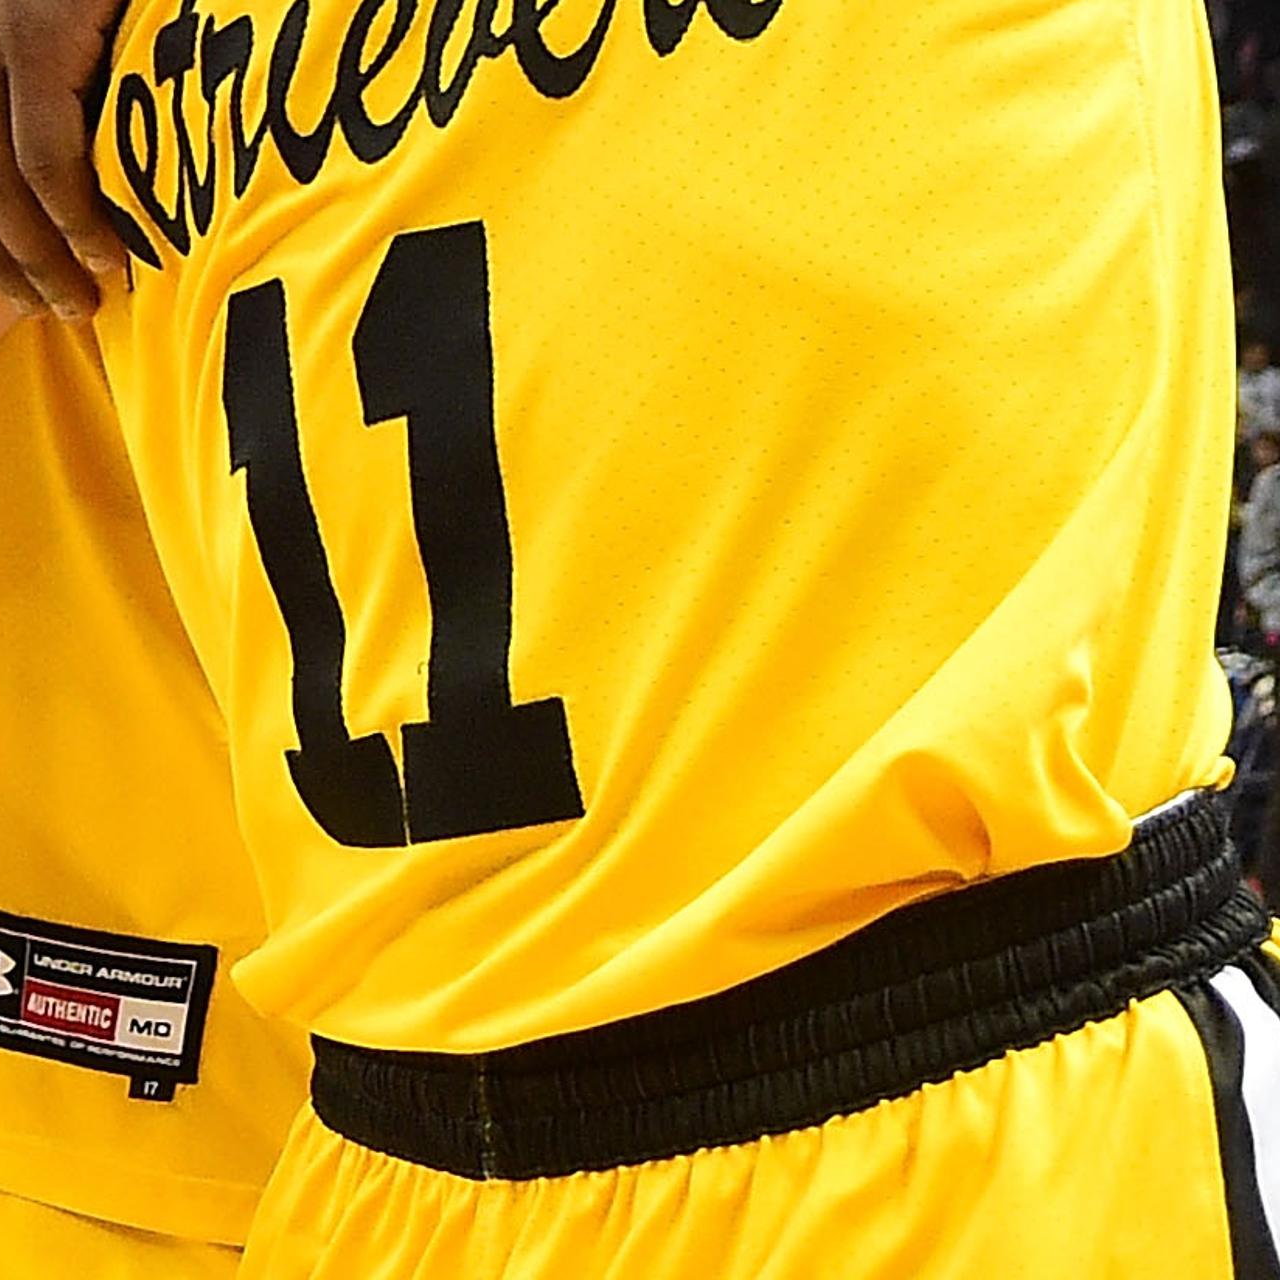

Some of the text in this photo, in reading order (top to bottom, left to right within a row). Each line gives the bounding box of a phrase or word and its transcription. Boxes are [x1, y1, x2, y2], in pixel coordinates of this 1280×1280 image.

[223, 220, 586, 847] 11
[33, 953, 183, 989] UNDER ARMOUR
[27, 992, 113, 1029] AUTHENTIC
[129, 1018, 172, 1038] MD
